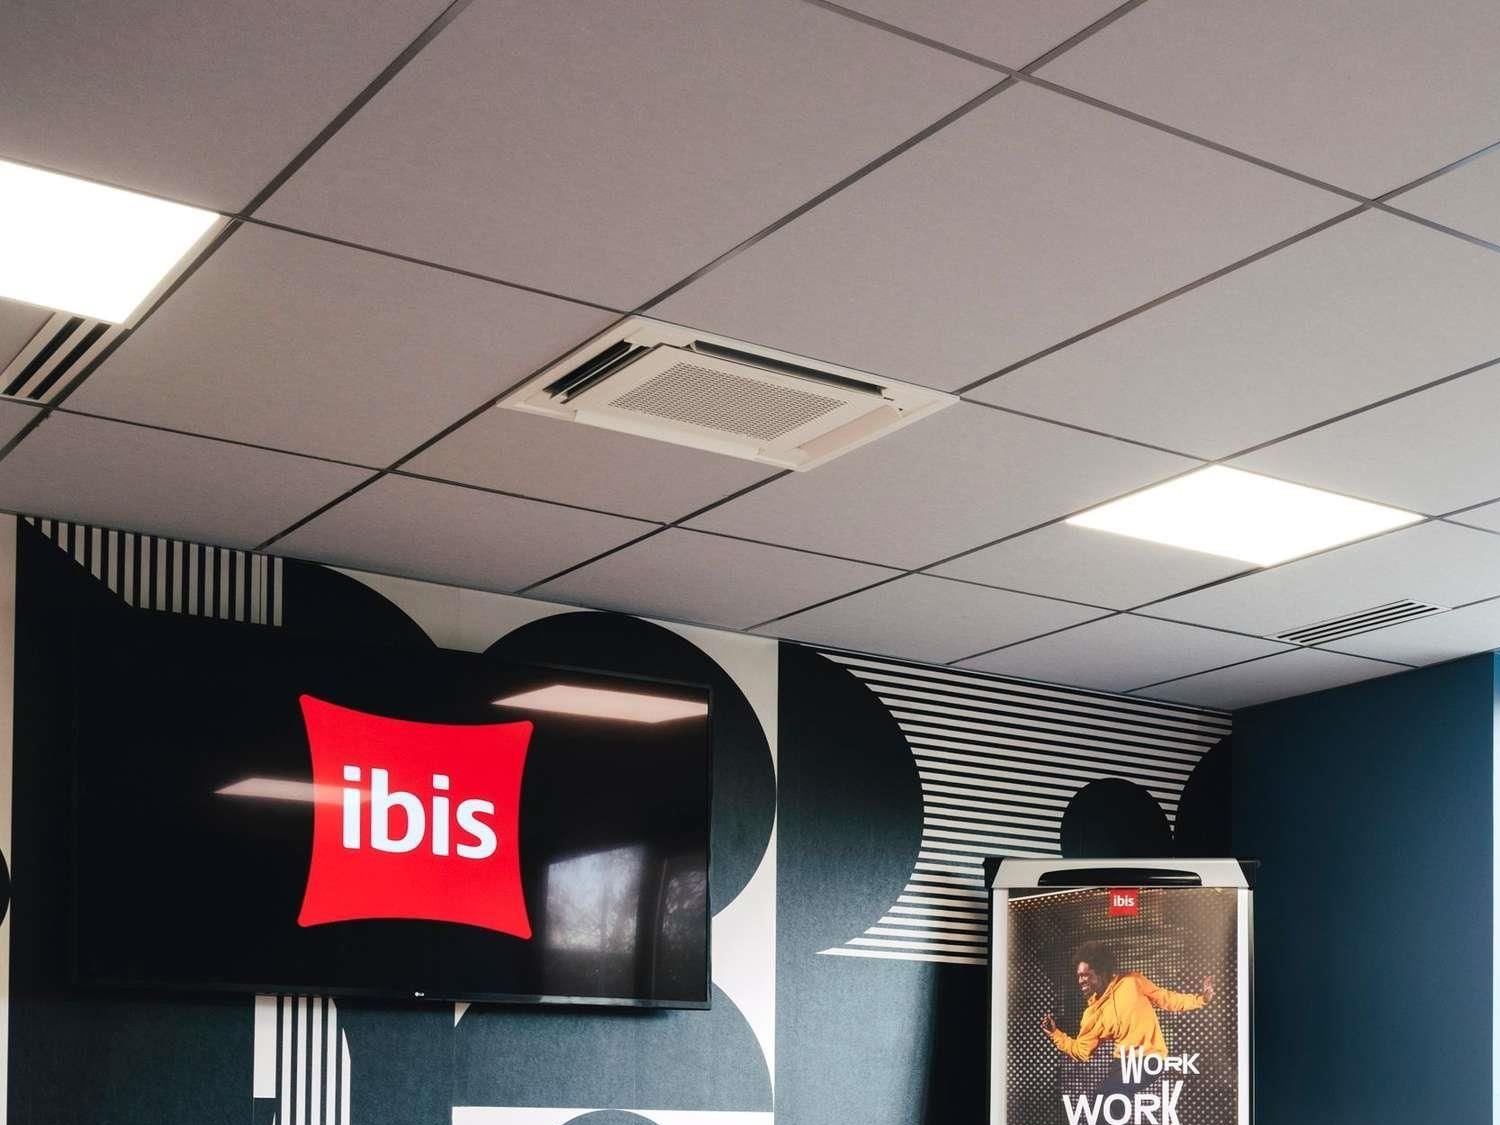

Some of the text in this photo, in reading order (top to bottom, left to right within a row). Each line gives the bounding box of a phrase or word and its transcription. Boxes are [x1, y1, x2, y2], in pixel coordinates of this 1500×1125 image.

[343, 765, 497, 860] ibis
[1113, 895, 1135, 907] ibis
[1120, 1045, 1200, 1084] WORK
